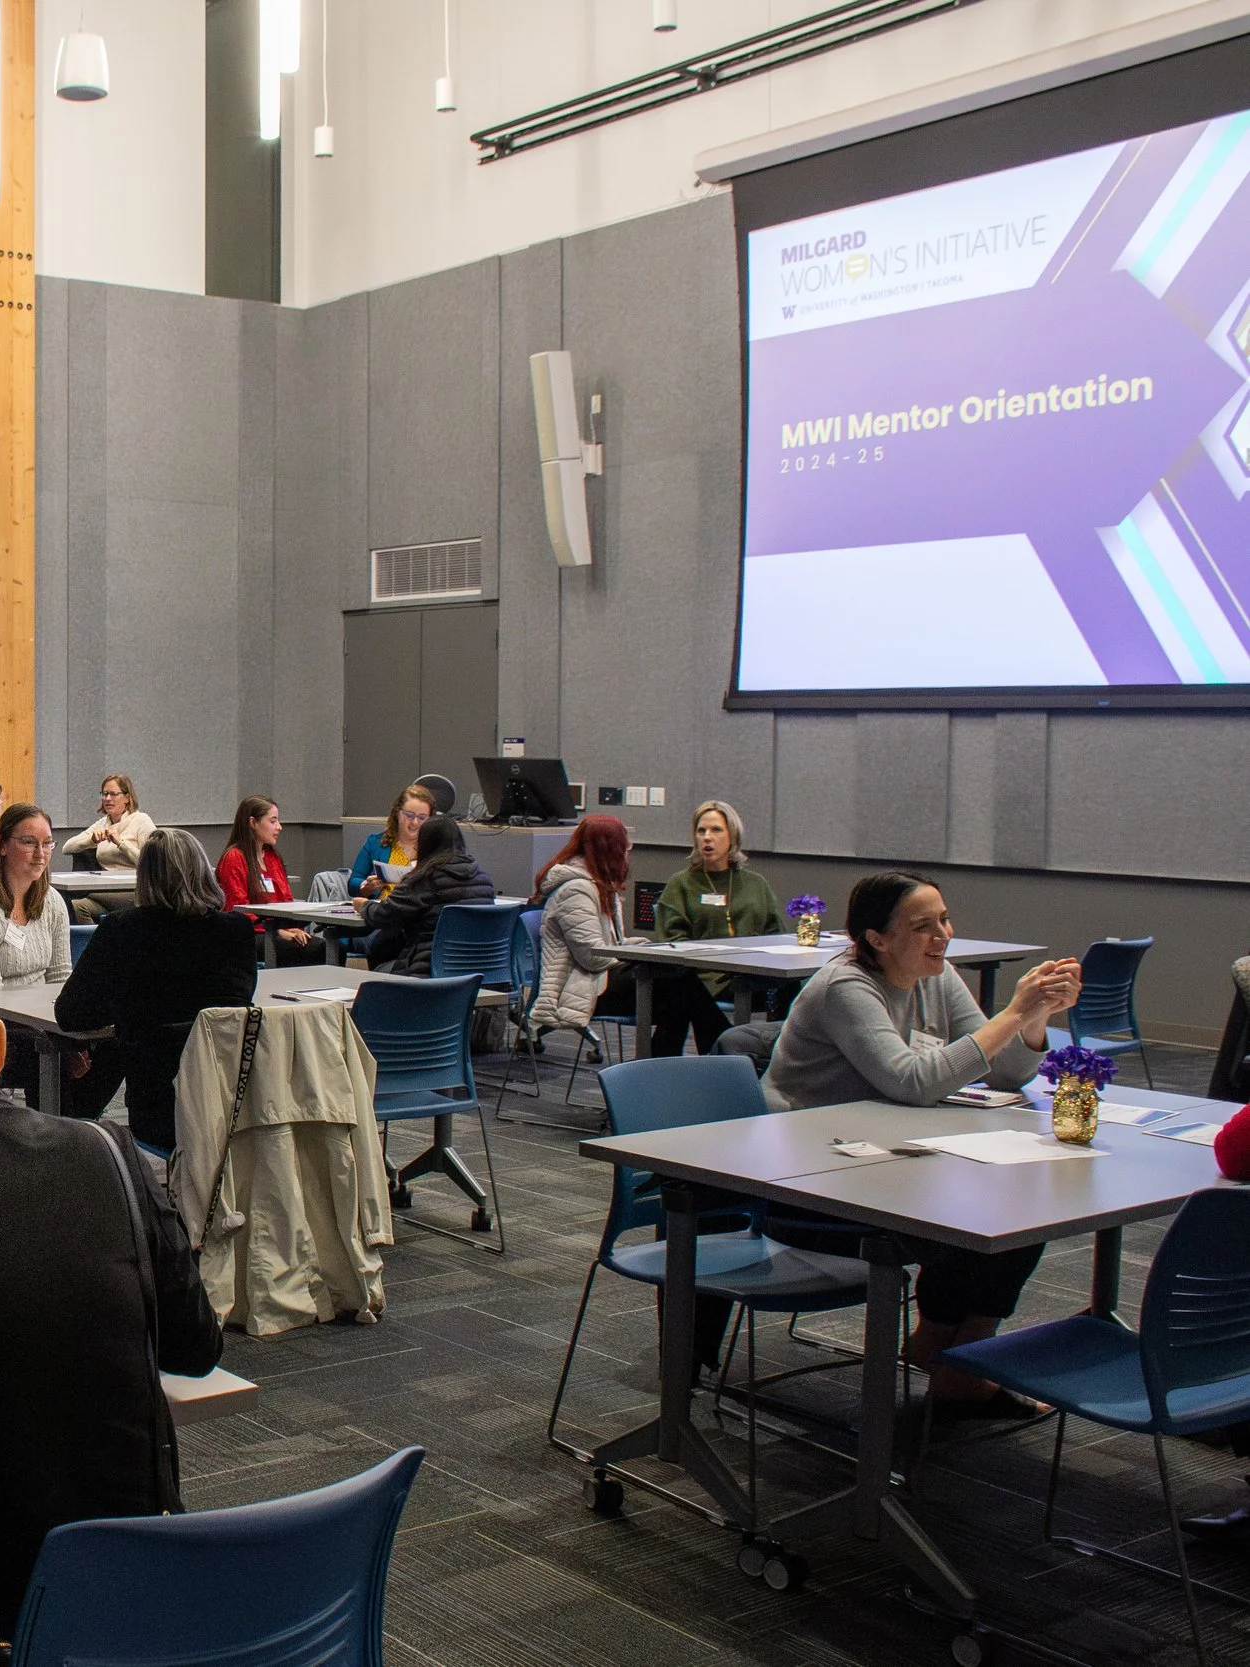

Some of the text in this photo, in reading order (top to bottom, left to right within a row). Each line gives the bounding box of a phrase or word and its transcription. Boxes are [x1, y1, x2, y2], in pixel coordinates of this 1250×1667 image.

[781, 229, 867, 265] MILGARD
[915, 213, 1049, 272] INITIATIVE
[800, 297, 848, 315] UNIVERSITY
[859, 282, 919, 303] WASHINGTON
[926, 273, 965, 291] TACOMA
[781, 372, 1154, 449] MWI Mentor Orientation
[780, 446, 885, 474] 2024-25
